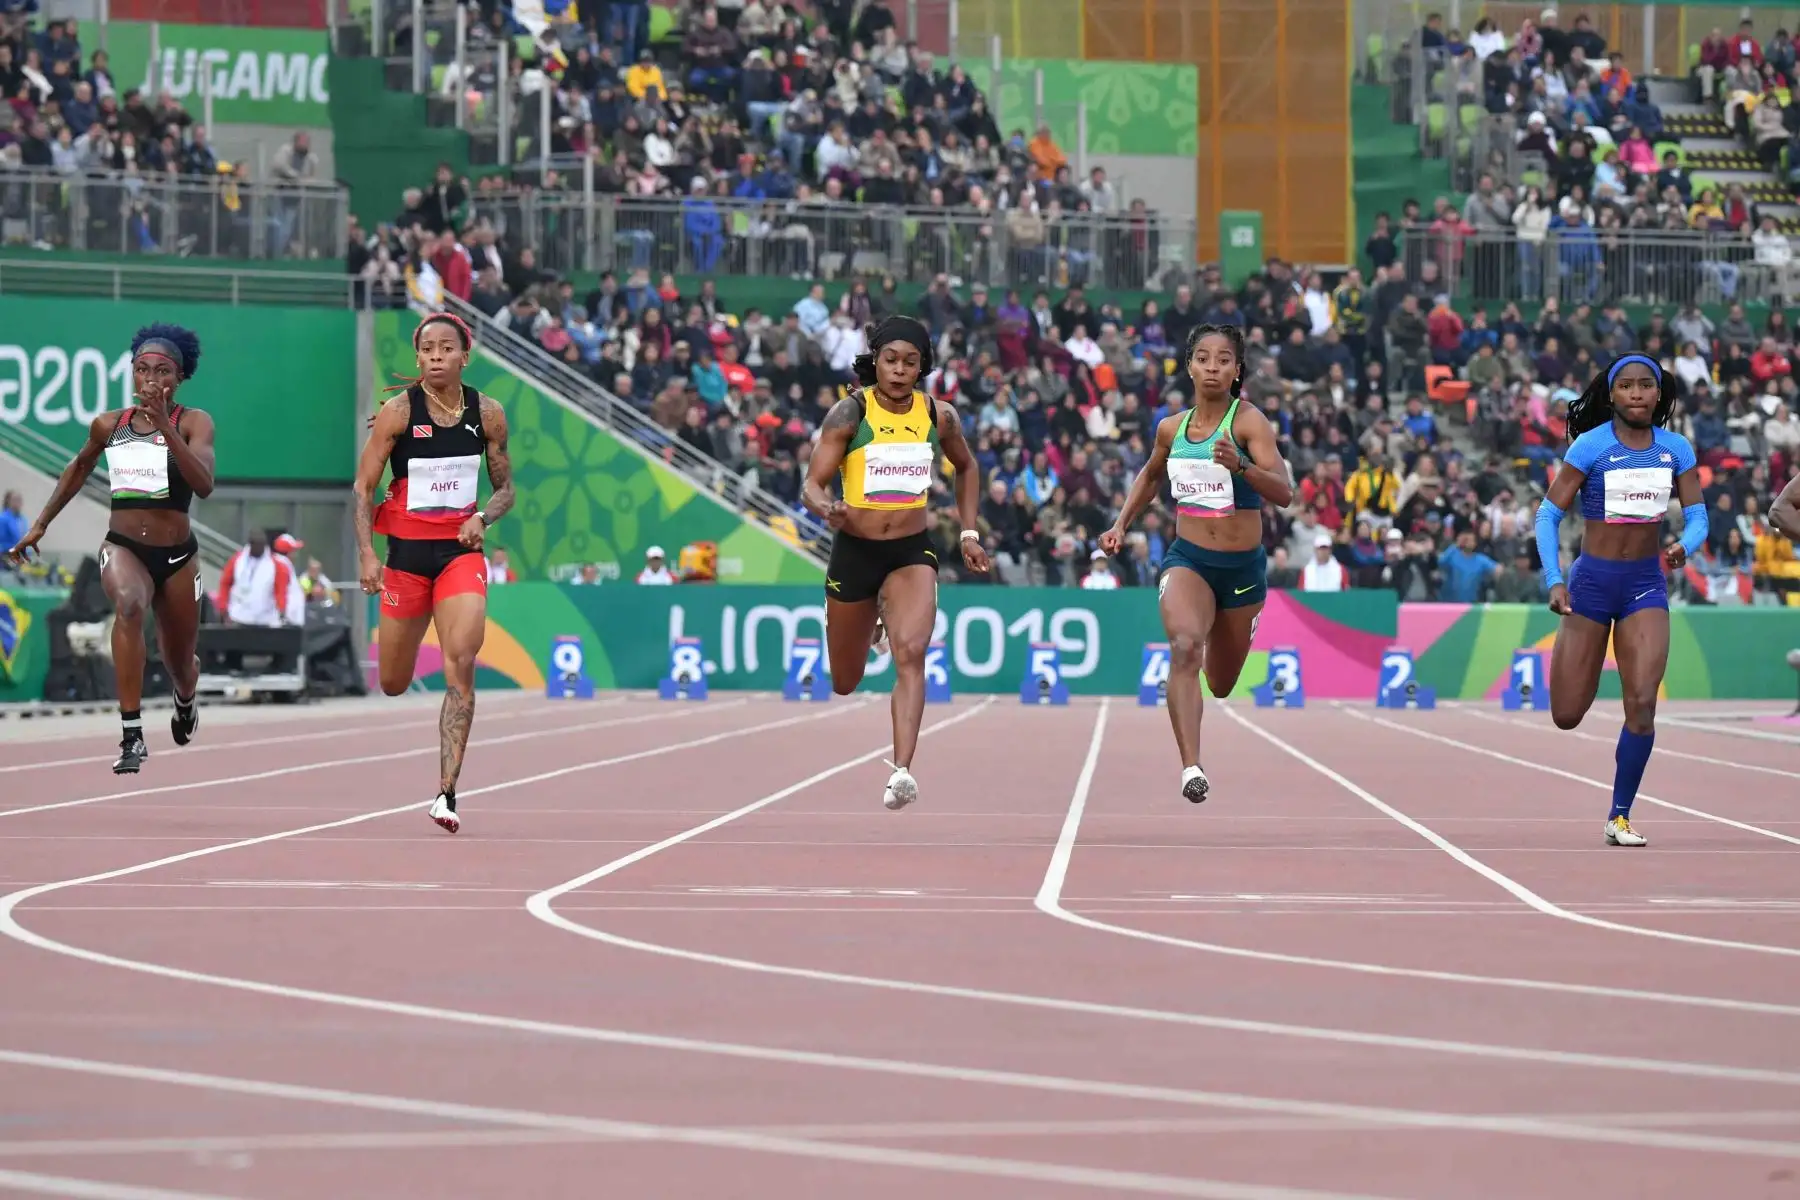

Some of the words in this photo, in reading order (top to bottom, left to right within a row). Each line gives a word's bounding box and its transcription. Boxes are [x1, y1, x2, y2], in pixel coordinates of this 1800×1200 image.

[113, 468, 156, 476] EMMANUEL
[430, 480, 459, 492] AHYE
[868, 466, 929, 476] THOMPSON
[1177, 482, 1225, 493] CRISTINA
[1622, 492, 1659, 502] TERRY
[553, 643, 582, 681] 9
[671, 645, 702, 683] 8
[793, 647, 821, 682] 7
[924, 649, 948, 686] 6
[1032, 650, 1057, 687] 5
[1142, 652, 1171, 687] 4
[1271, 653, 1299, 692] 3
[1382, 655, 1412, 698] 2
[1513, 656, 1534, 689] 1
